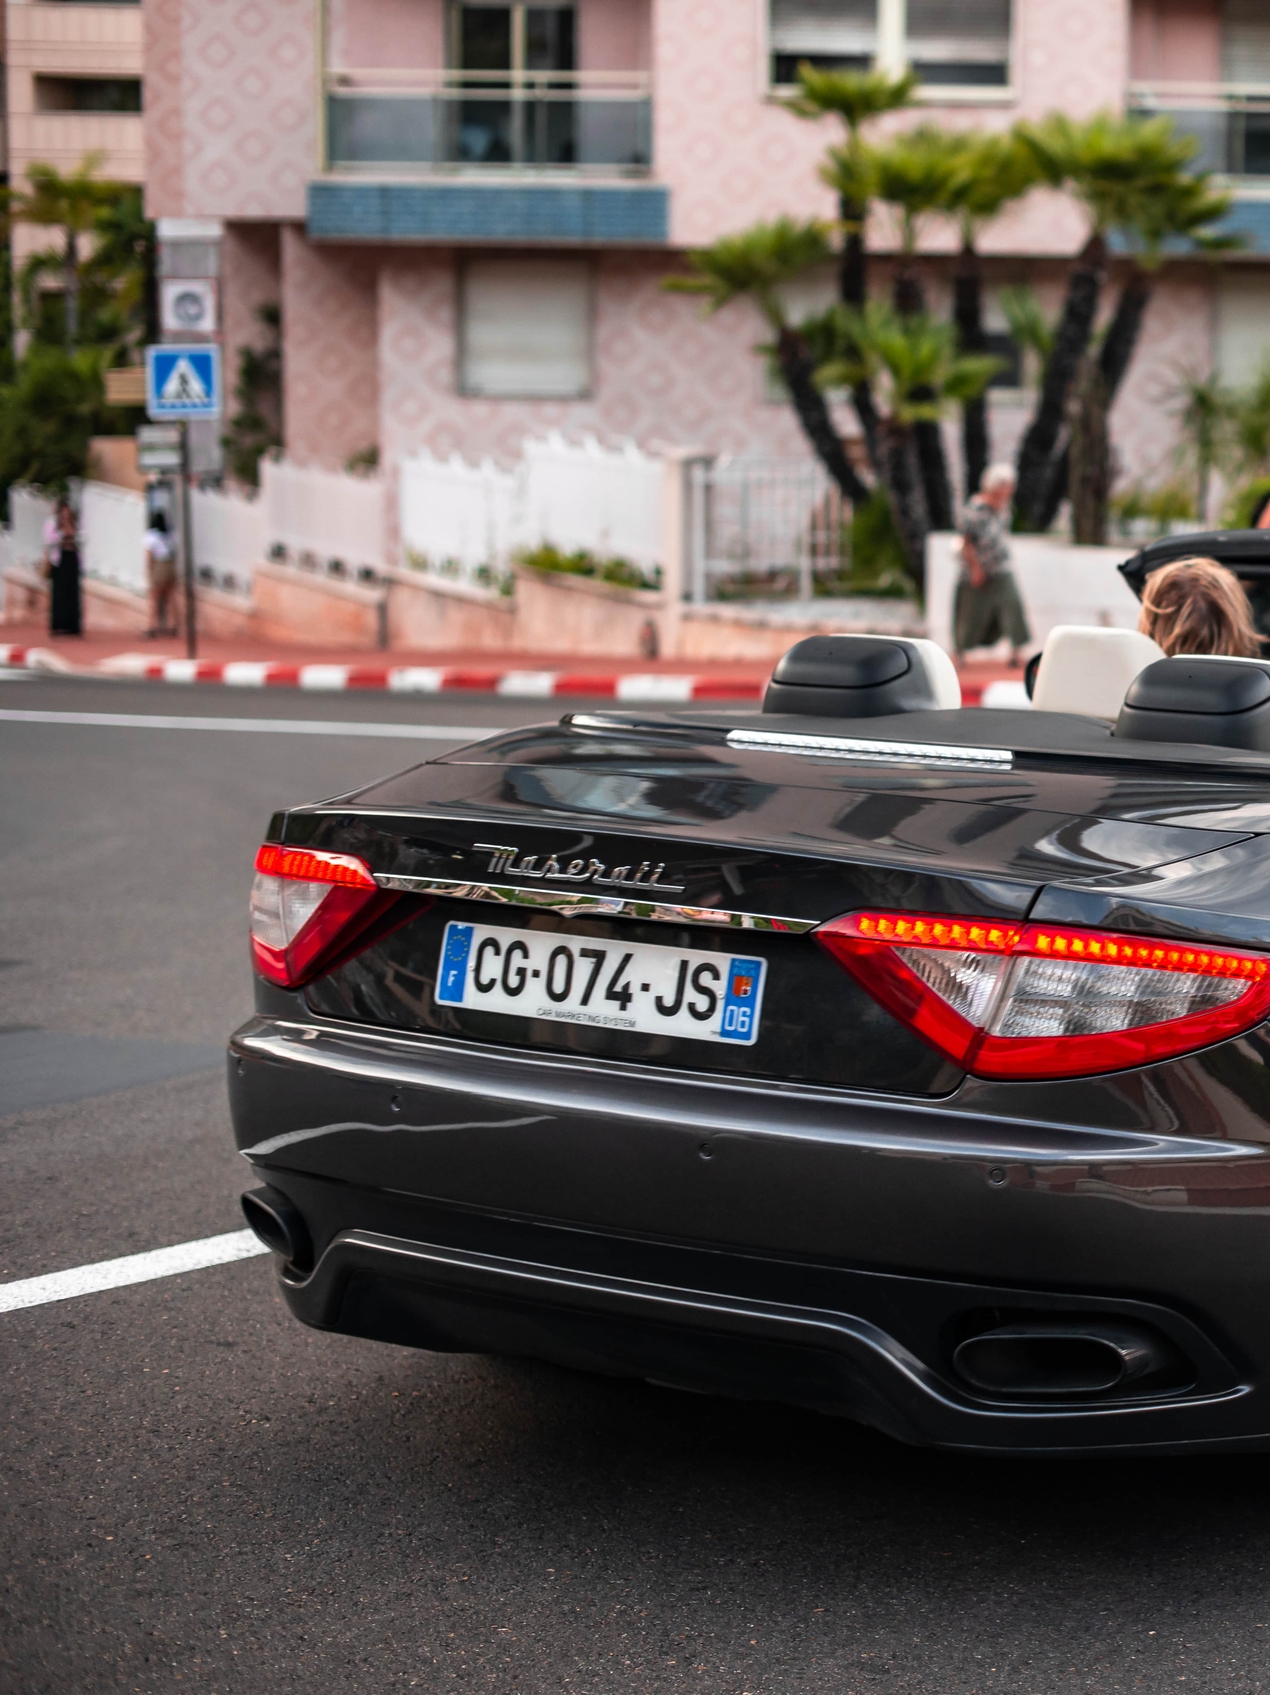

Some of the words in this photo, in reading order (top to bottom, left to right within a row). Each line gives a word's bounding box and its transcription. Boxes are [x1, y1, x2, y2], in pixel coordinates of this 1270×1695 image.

[472, 843, 685, 893] Maserati
[447, 970, 459, 987] F
[474, 937, 721, 1021] CG-074-JS
[536, 1007, 553, 1017] CAR
[554, 1010, 602, 1024] MARKETING
[602, 1015, 637, 1028] SYSTEM
[724, 1005, 751, 1033] 06
